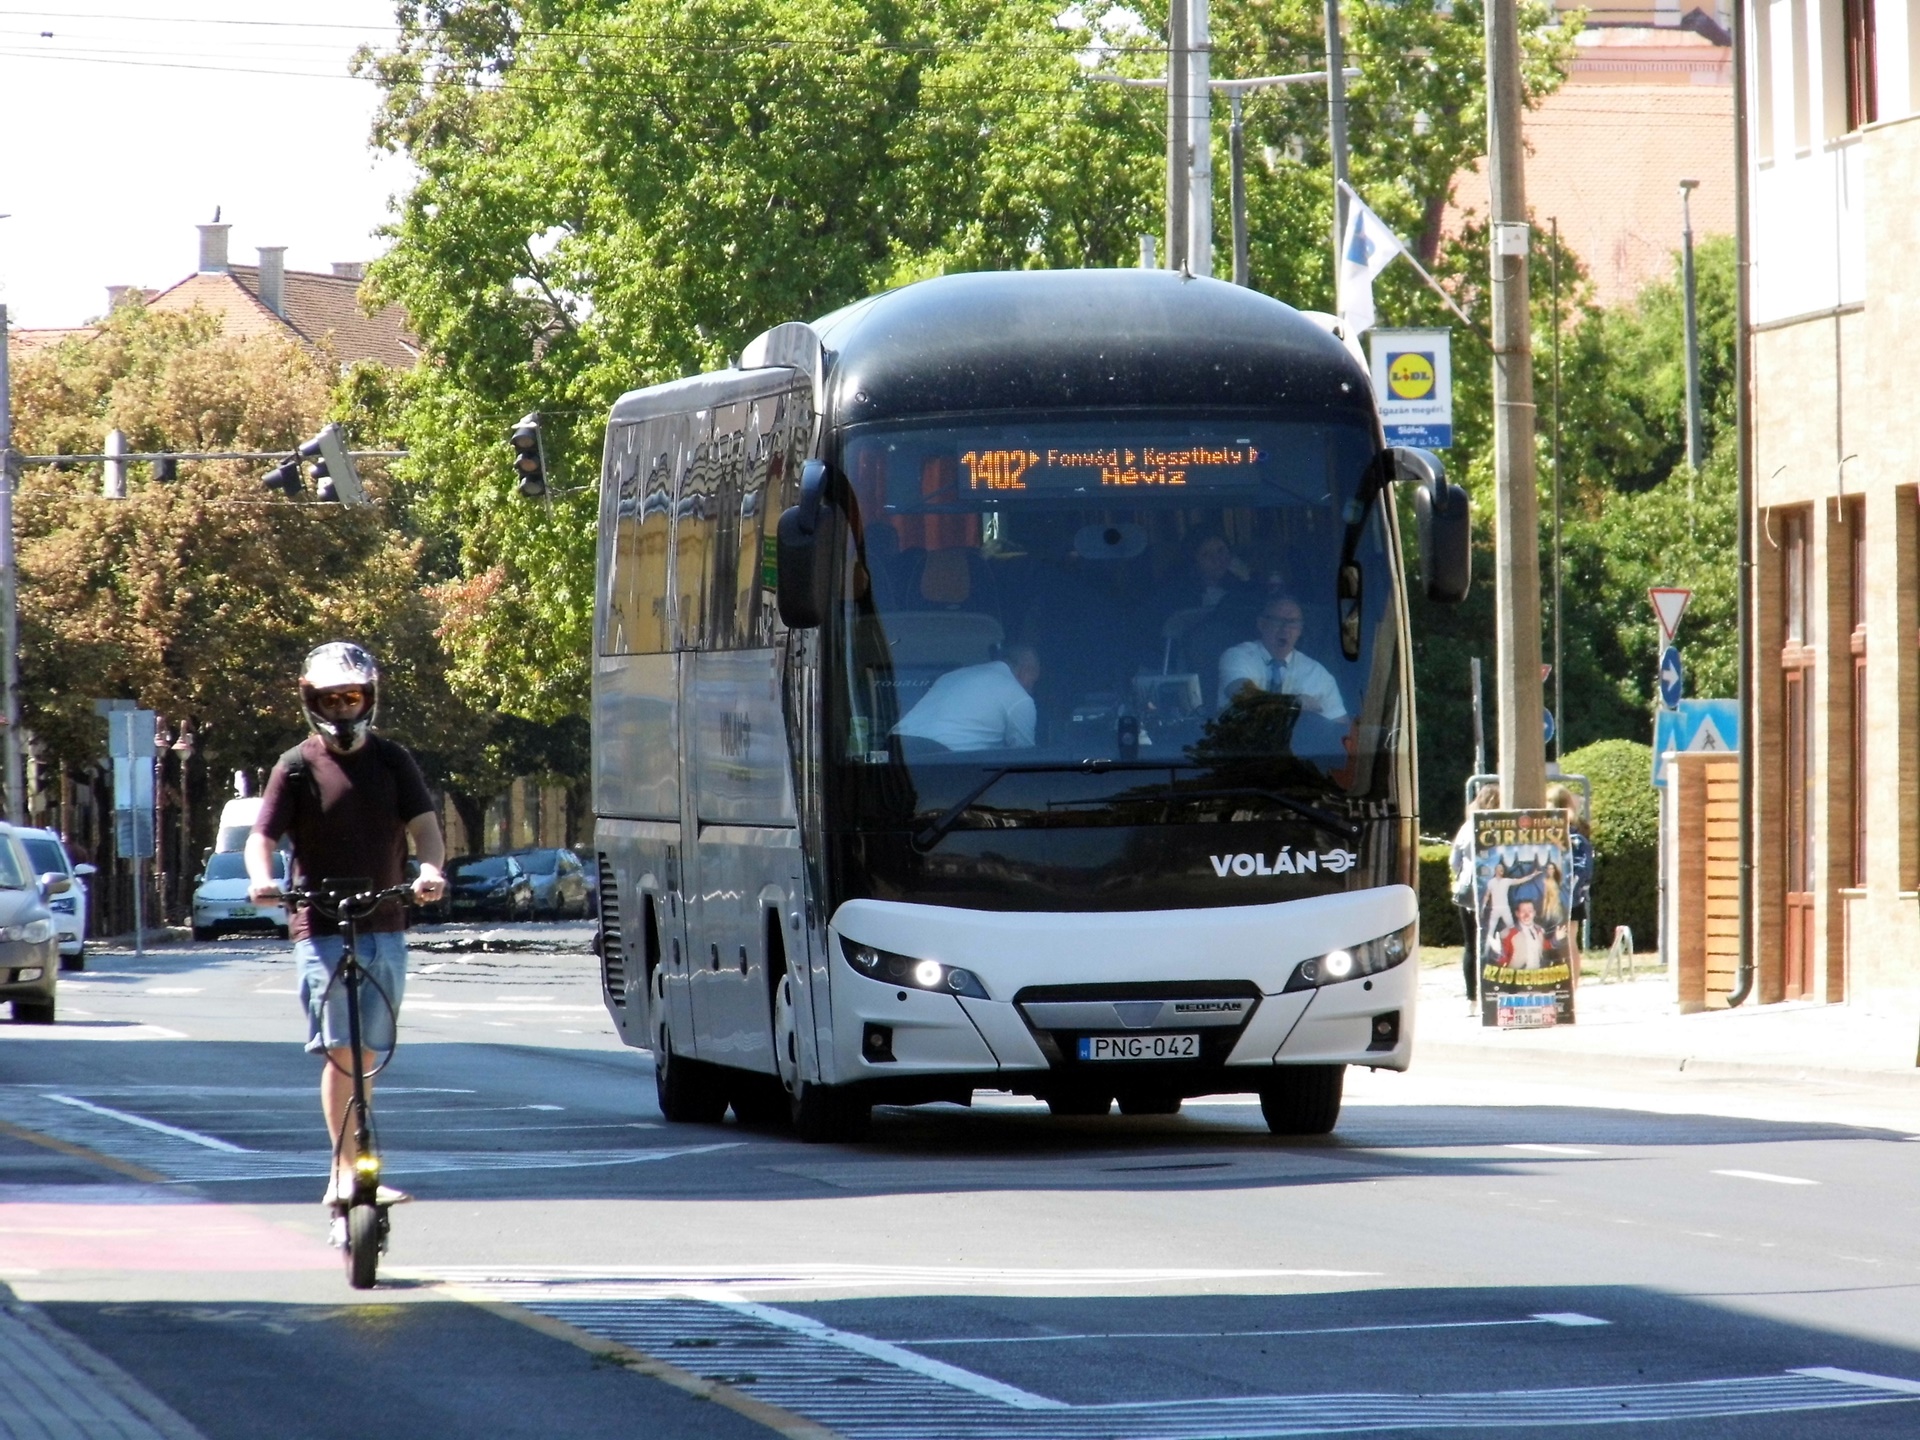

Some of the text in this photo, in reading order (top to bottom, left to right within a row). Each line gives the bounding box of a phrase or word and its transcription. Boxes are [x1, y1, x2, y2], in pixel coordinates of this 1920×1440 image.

[1048, 447, 1242, 466] Fonyód Keszthely
[961, 450, 1026, 489] 1402
[1102, 466, 1187, 484] Hévíz
[1479, 819, 1516, 830] RICHTER
[1479, 827, 1567, 850] CIRKUSZ
[1209, 845, 1317, 877] VOLÁN
[1175, 1002, 1242, 1013] NEOPLAN
[1095, 1037, 1194, 1058] PNG-042
